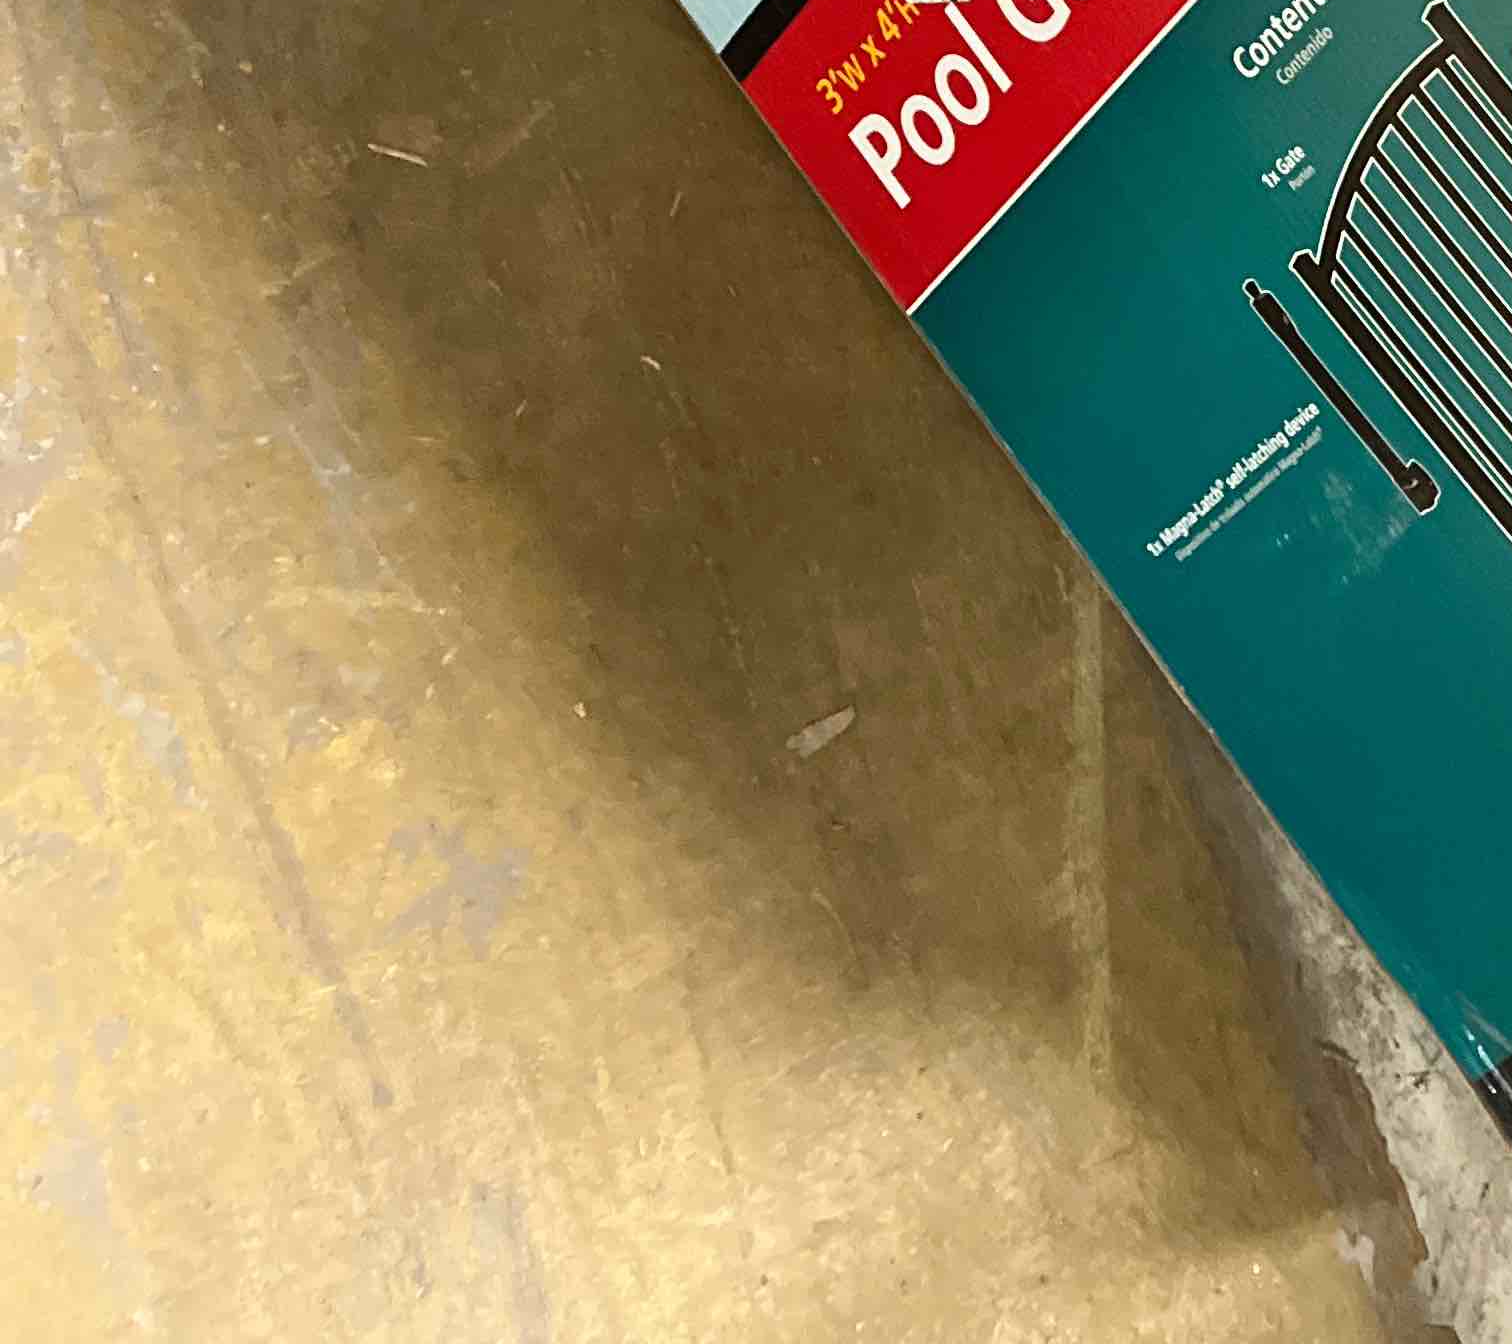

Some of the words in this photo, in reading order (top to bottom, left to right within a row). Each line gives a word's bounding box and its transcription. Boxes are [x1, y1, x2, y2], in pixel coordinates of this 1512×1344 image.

[1275, 26, 1333, 84] Contenido
[847, 2, 1013, 210] Pool
[1260, 169, 1281, 188] 1x
[1275, 145, 1305, 174] Gate
[1225, 431, 1289, 489] self-latching
[1283, 402, 1319, 436] device
